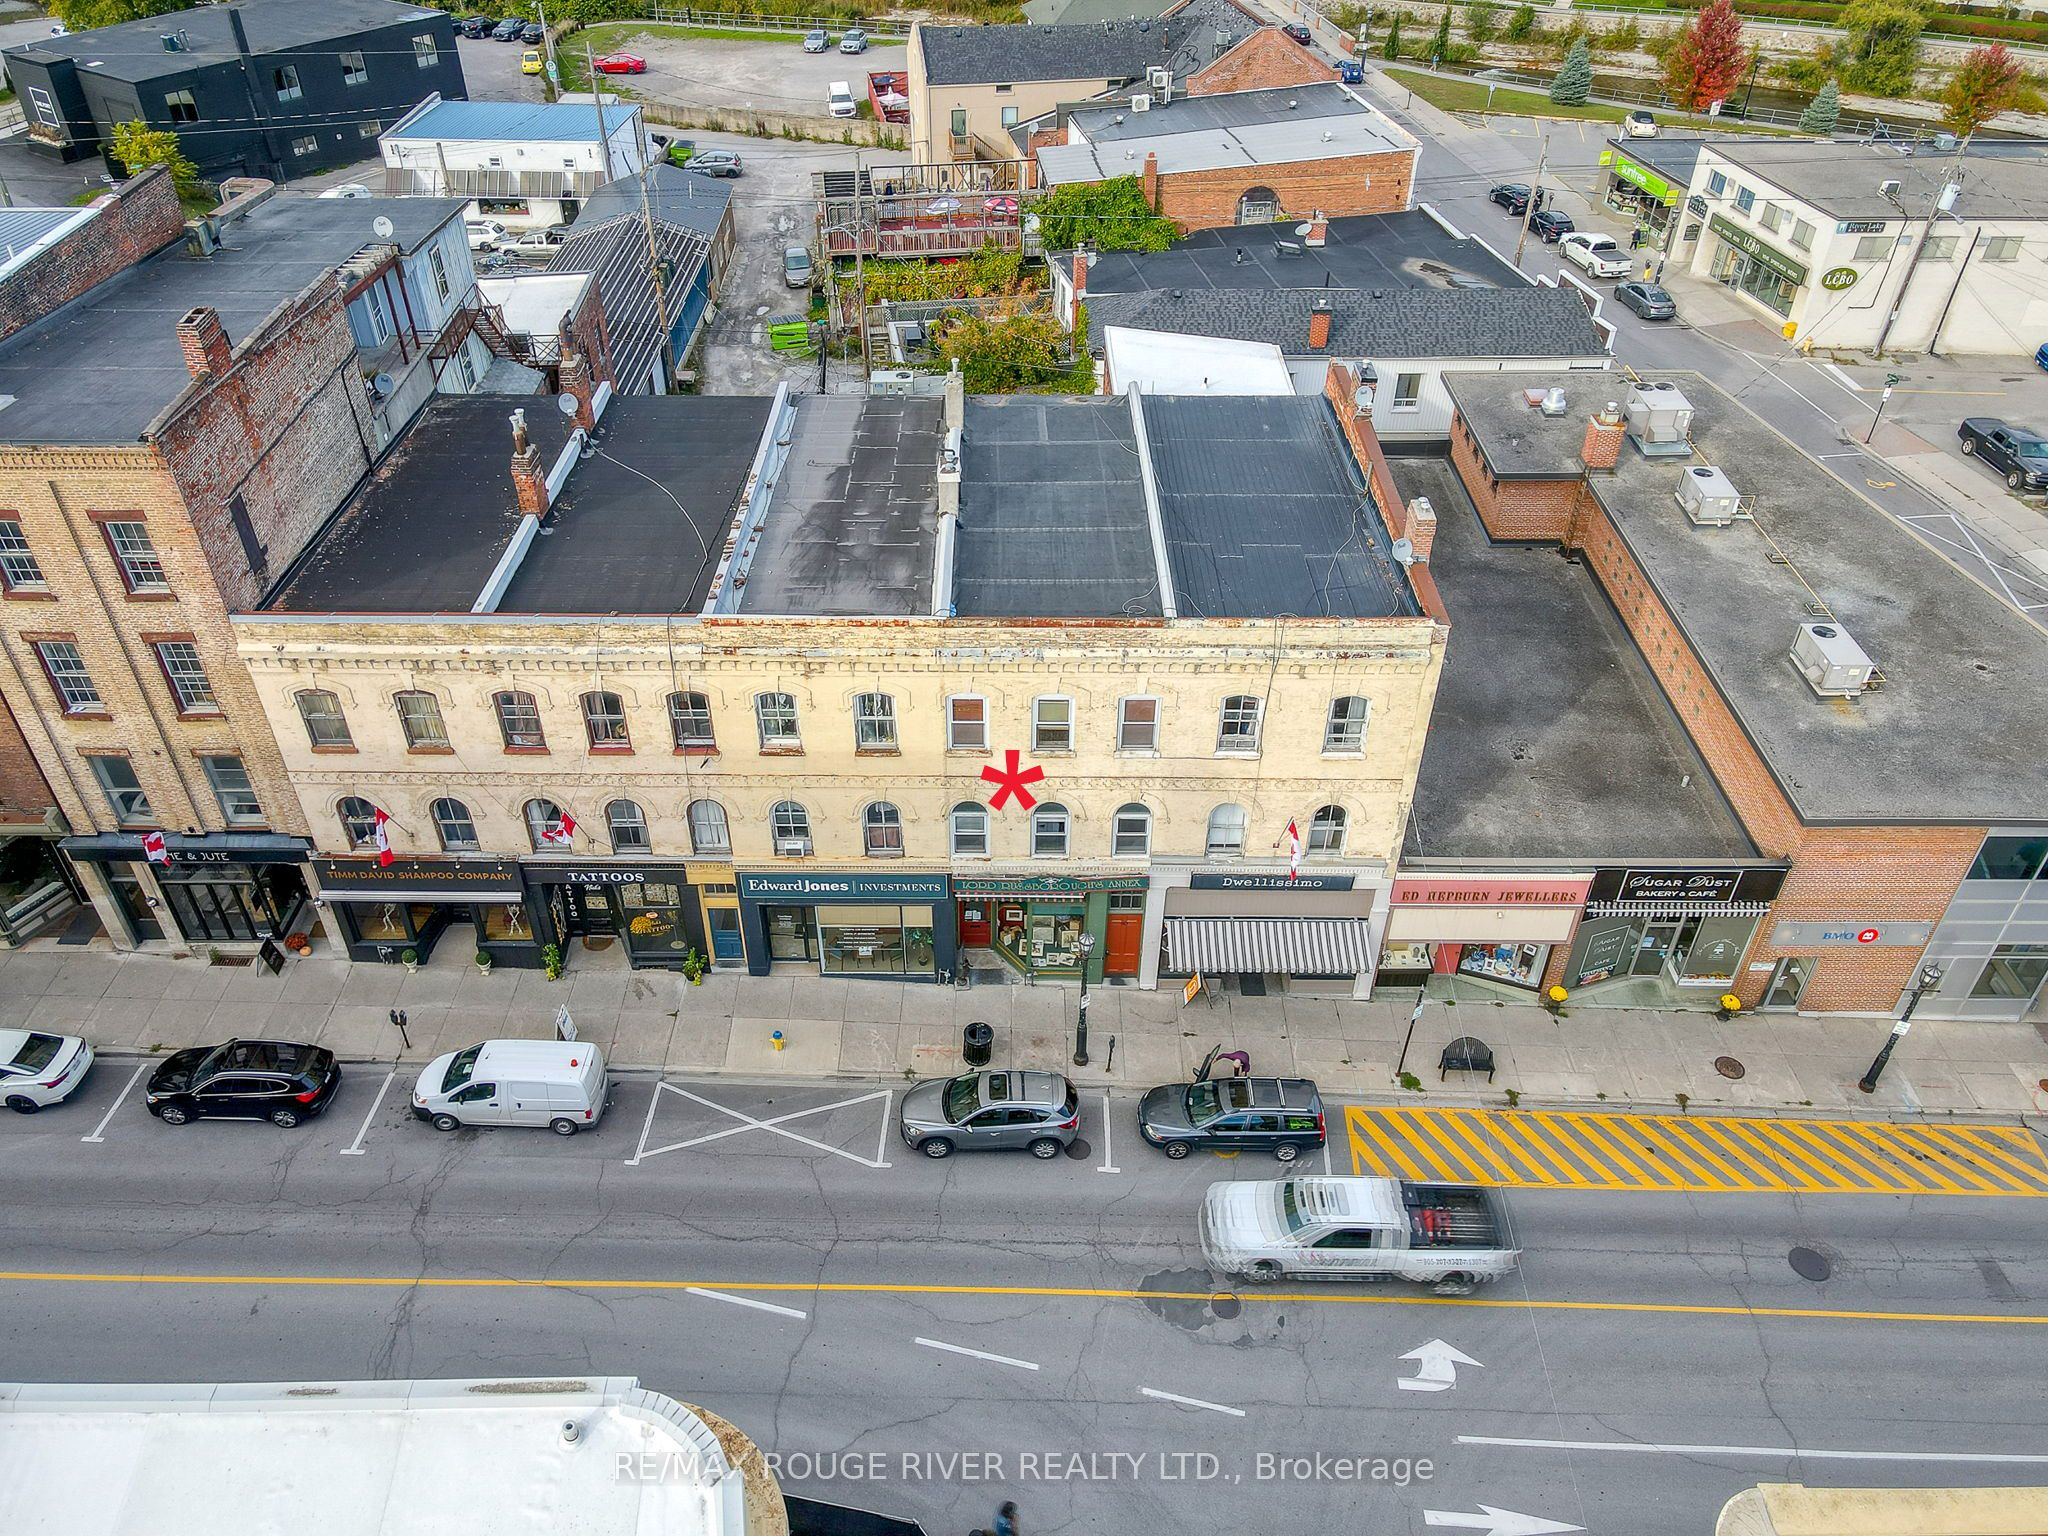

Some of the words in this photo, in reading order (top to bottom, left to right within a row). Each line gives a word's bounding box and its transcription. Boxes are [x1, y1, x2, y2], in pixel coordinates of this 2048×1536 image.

[1742, 236, 1760, 254] LCBO
[1825, 274, 1854, 285] LCBO
[326, 871, 357, 880] TIMM
[359, 871, 395, 880] DAVID
[399, 872, 455, 880] SHAMPOO
[457, 872, 513, 881] COMPANY
[567, 872, 645, 882] TATTOOS
[859, 883, 941, 892] INVESTMENTS
[962, 881, 995, 890] LORD
[1108, 879, 1142, 888] ANNEX
[1222, 877, 1323, 888] Dwellissimo
[1629, 875, 1682, 889] SUGAR
[1686, 875, 1733, 888] DUST
[1402, 891, 1419, 900] ED
[1427, 891, 1490, 901] HEPBURN
[1498, 891, 1577, 902] JEWELLERS
[1823, 932, 1855, 940] BMO
